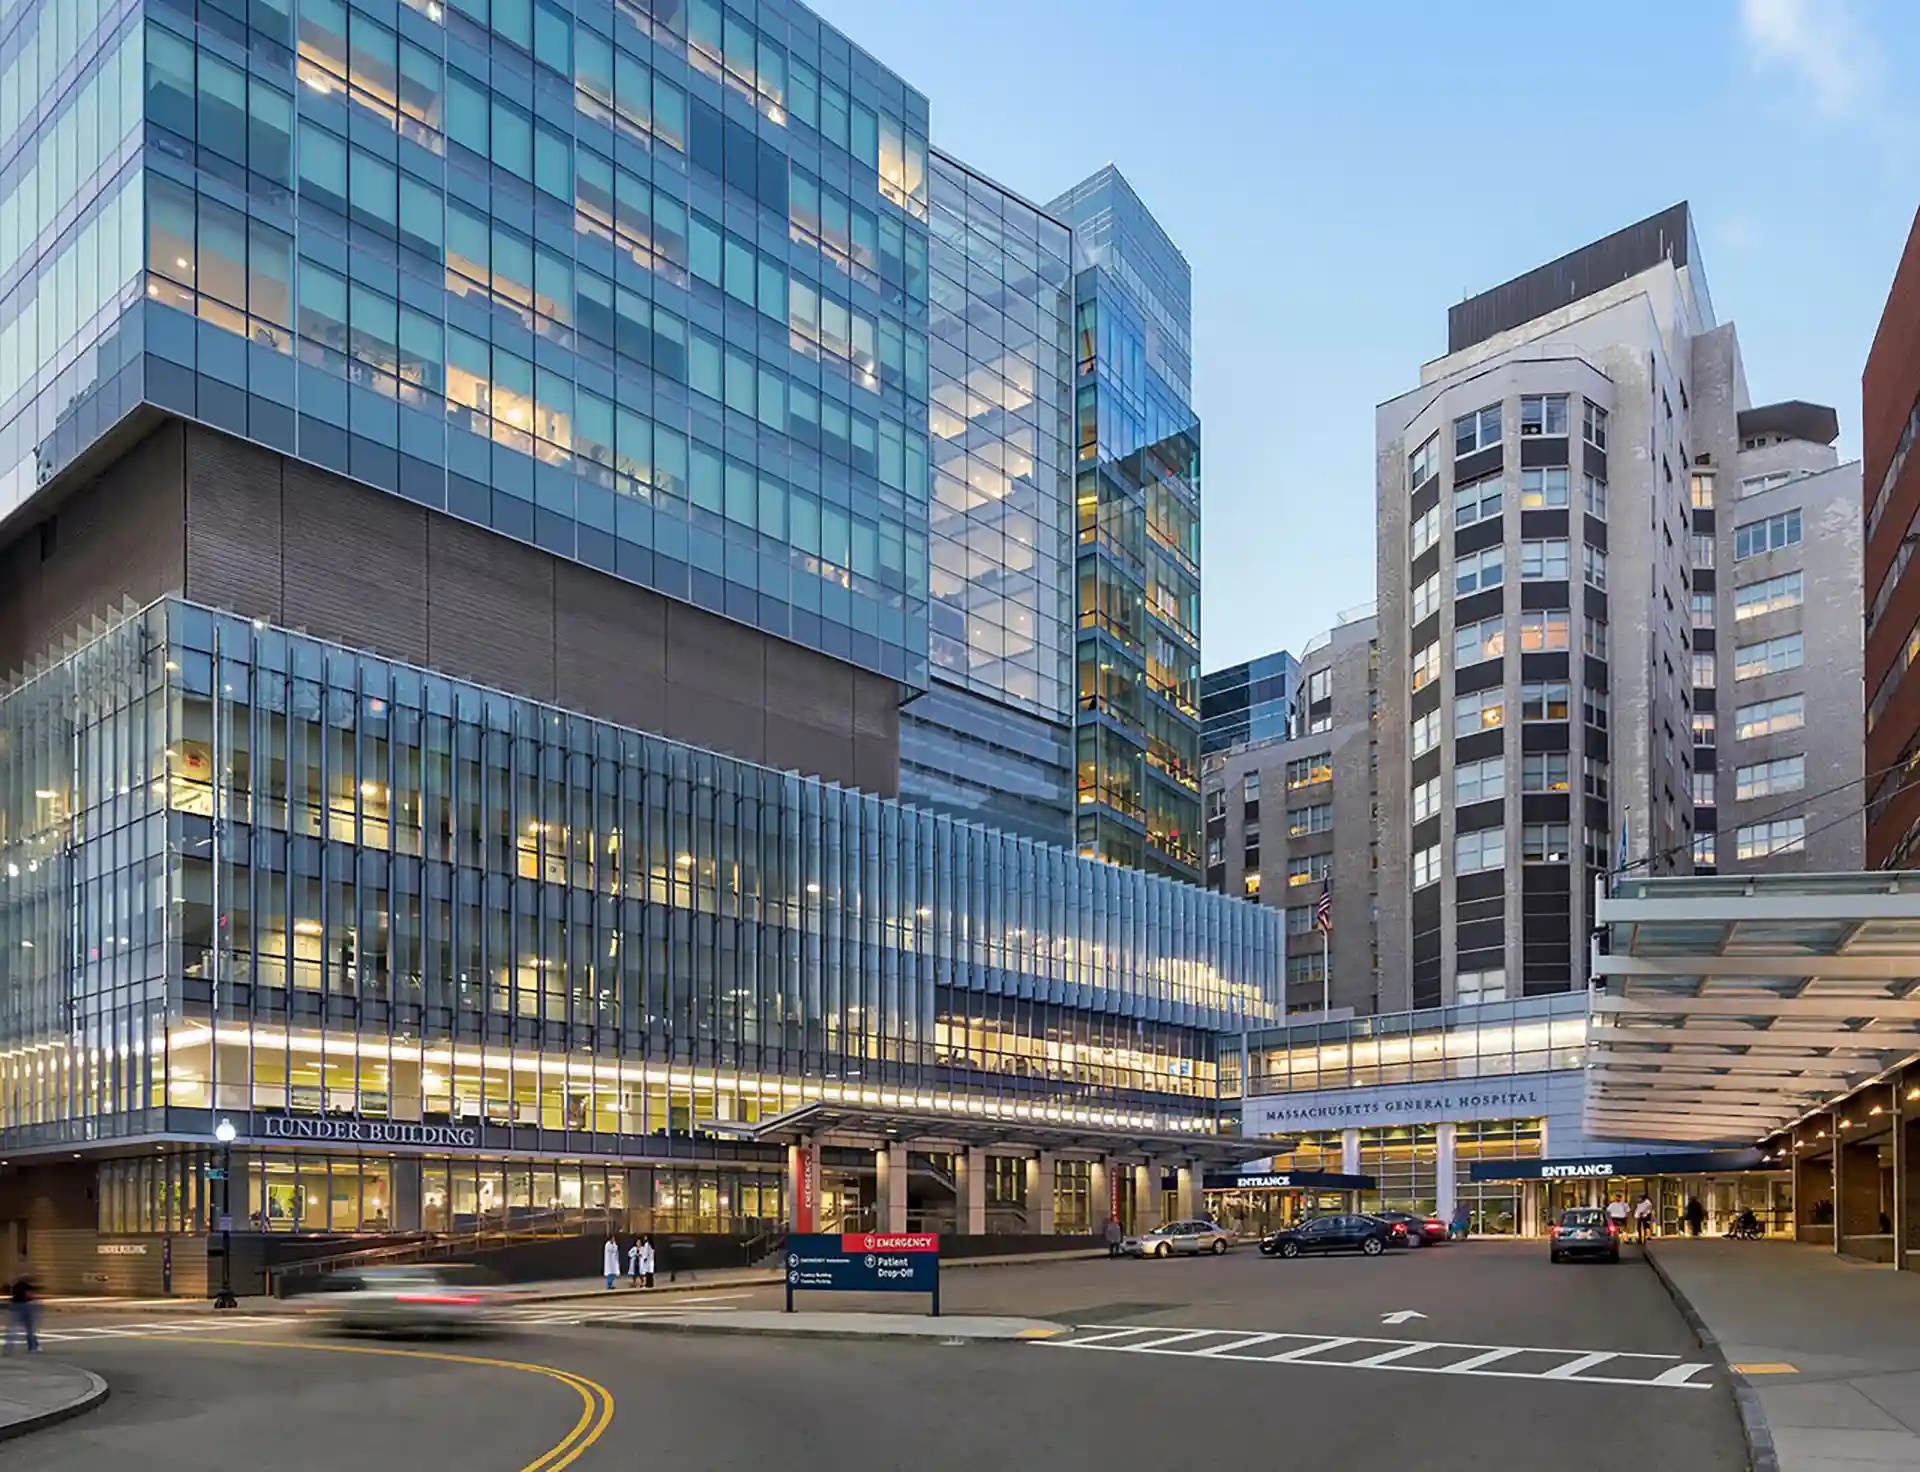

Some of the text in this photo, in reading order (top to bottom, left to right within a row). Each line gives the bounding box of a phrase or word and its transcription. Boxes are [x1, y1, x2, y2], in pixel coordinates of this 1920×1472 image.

[1266, 1091, 1537, 1120] MASSACHUSETTS GENERAL HOSPITAL
[264, 1116, 476, 1146] LUNDER BUILDING
[1541, 1163, 1613, 1177] ENTRANCE
[804, 1155, 812, 1208] EMERGENCY
[1237, 1175, 1291, 1187] ENTRANCE
[876, 1237, 932, 1248] EMERGENCY
[878, 1256, 909, 1267] Patient
[878, 1268, 914, 1279] Drop-Off
